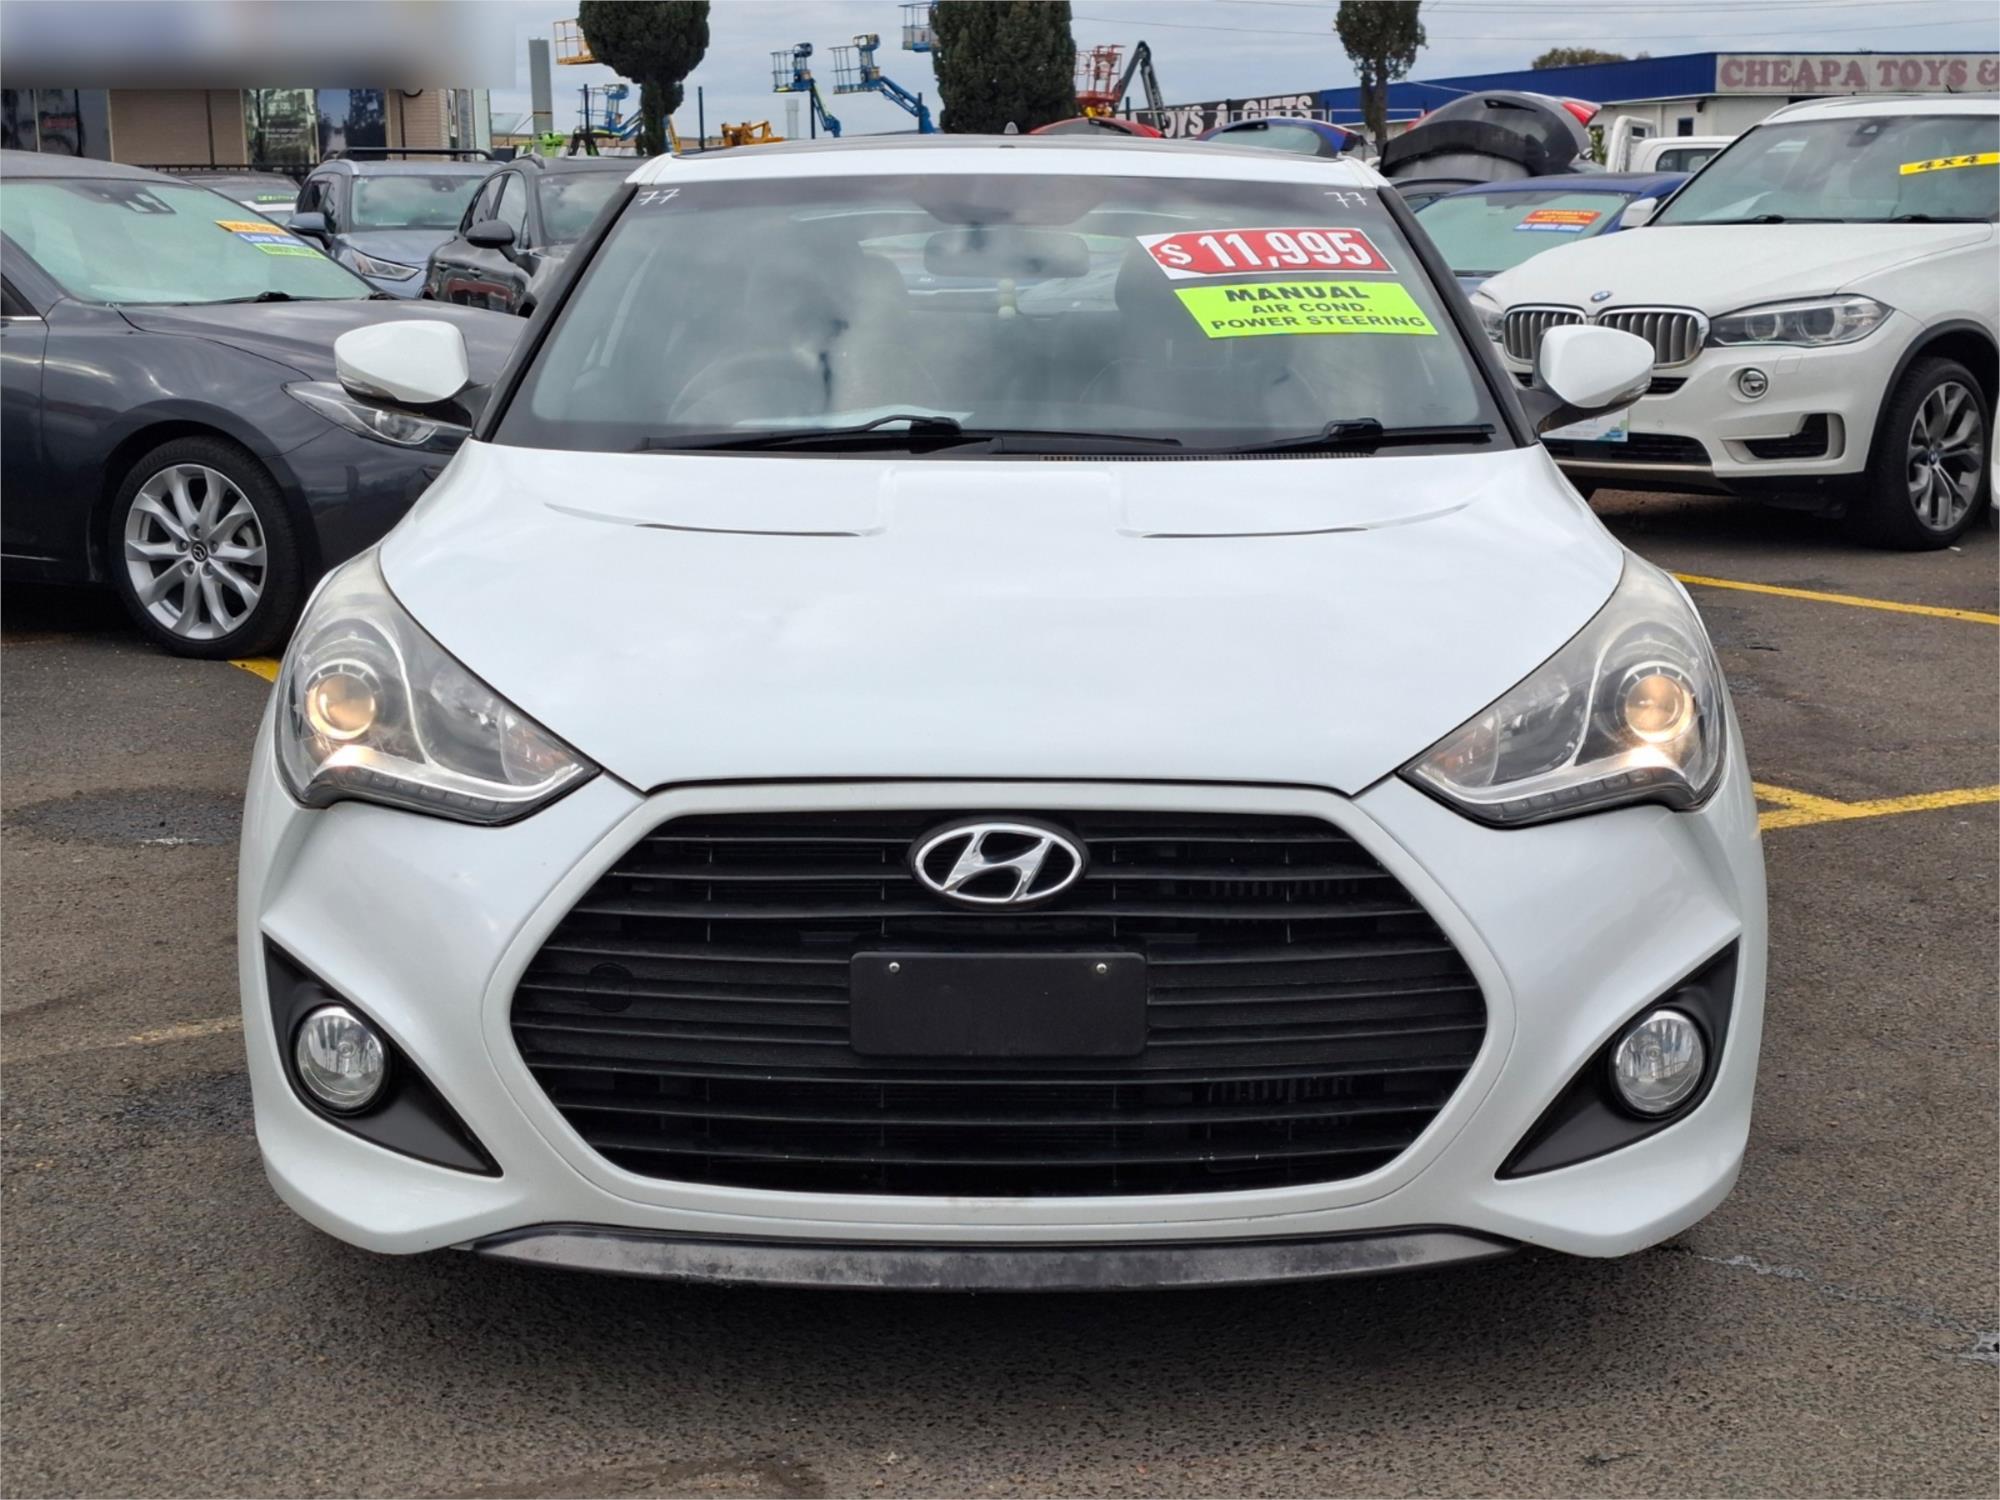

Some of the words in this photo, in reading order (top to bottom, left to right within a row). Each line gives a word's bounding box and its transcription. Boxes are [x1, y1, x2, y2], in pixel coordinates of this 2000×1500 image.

[1720, 59, 1867, 87] CHEAPA
[1877, 59, 1968, 87] TOYS
[1148, 105, 1204, 138] OYS
[1323, 191, 1368, 208] 77
[1197, 231, 1373, 268] 11,995
[1224, 286, 1371, 302] MANUAL
[1251, 303, 1291, 315] AIR
[1299, 302, 1373, 313] COND.
[1210, 316, 1300, 330] POWER
[1305, 315, 1427, 328] STEERING
